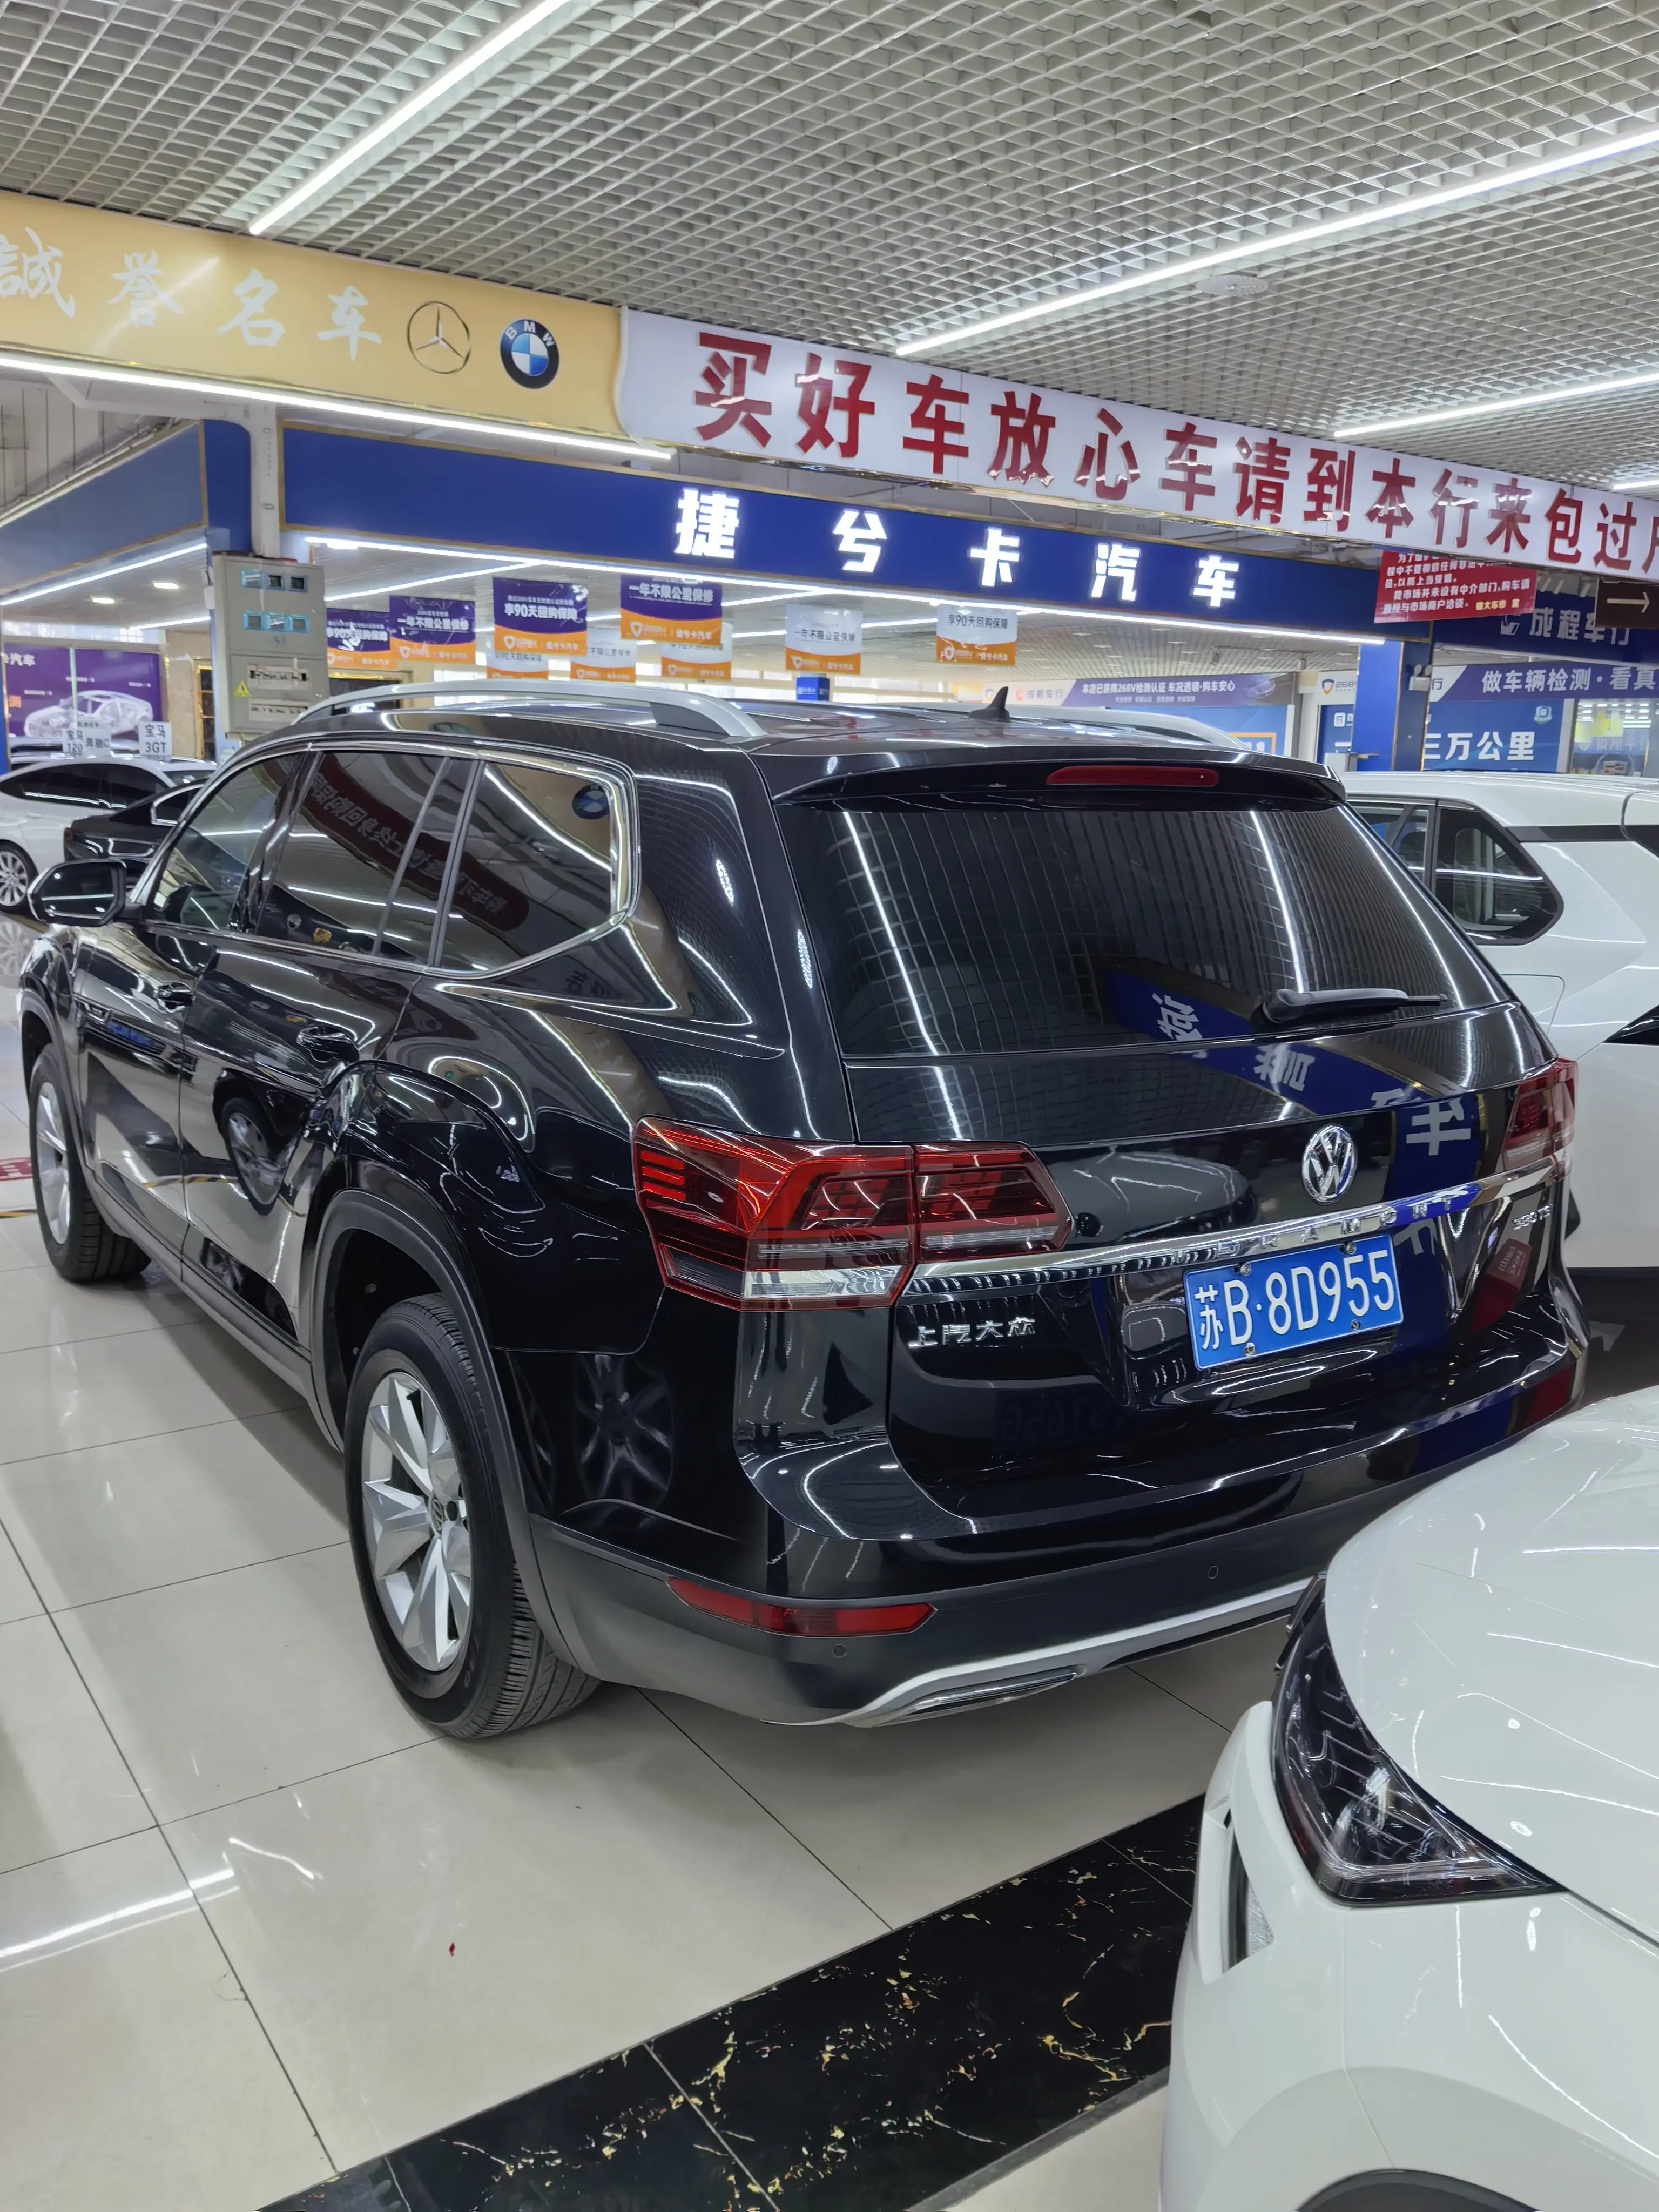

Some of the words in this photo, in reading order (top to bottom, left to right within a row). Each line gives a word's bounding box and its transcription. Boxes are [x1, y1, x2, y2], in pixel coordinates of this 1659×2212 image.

[505, 321, 555, 347] BMW
[673, 486, 1240, 608] 捷兮卡汽车
[629, 582, 714, 603] 一年不限公里保修
[504, 603, 578, 621] 享90天回购保障
[948, 613, 1008, 629] 享90天回购保障
[1482, 667, 1659, 693] 做车辆检测·看真
[145, 724, 166, 738] 宝马
[145, 741, 167, 753] 3GT
[1194, 1249, 1395, 1351] 苏B·8D955
[907, 1317, 1036, 1348] 上汽大众
